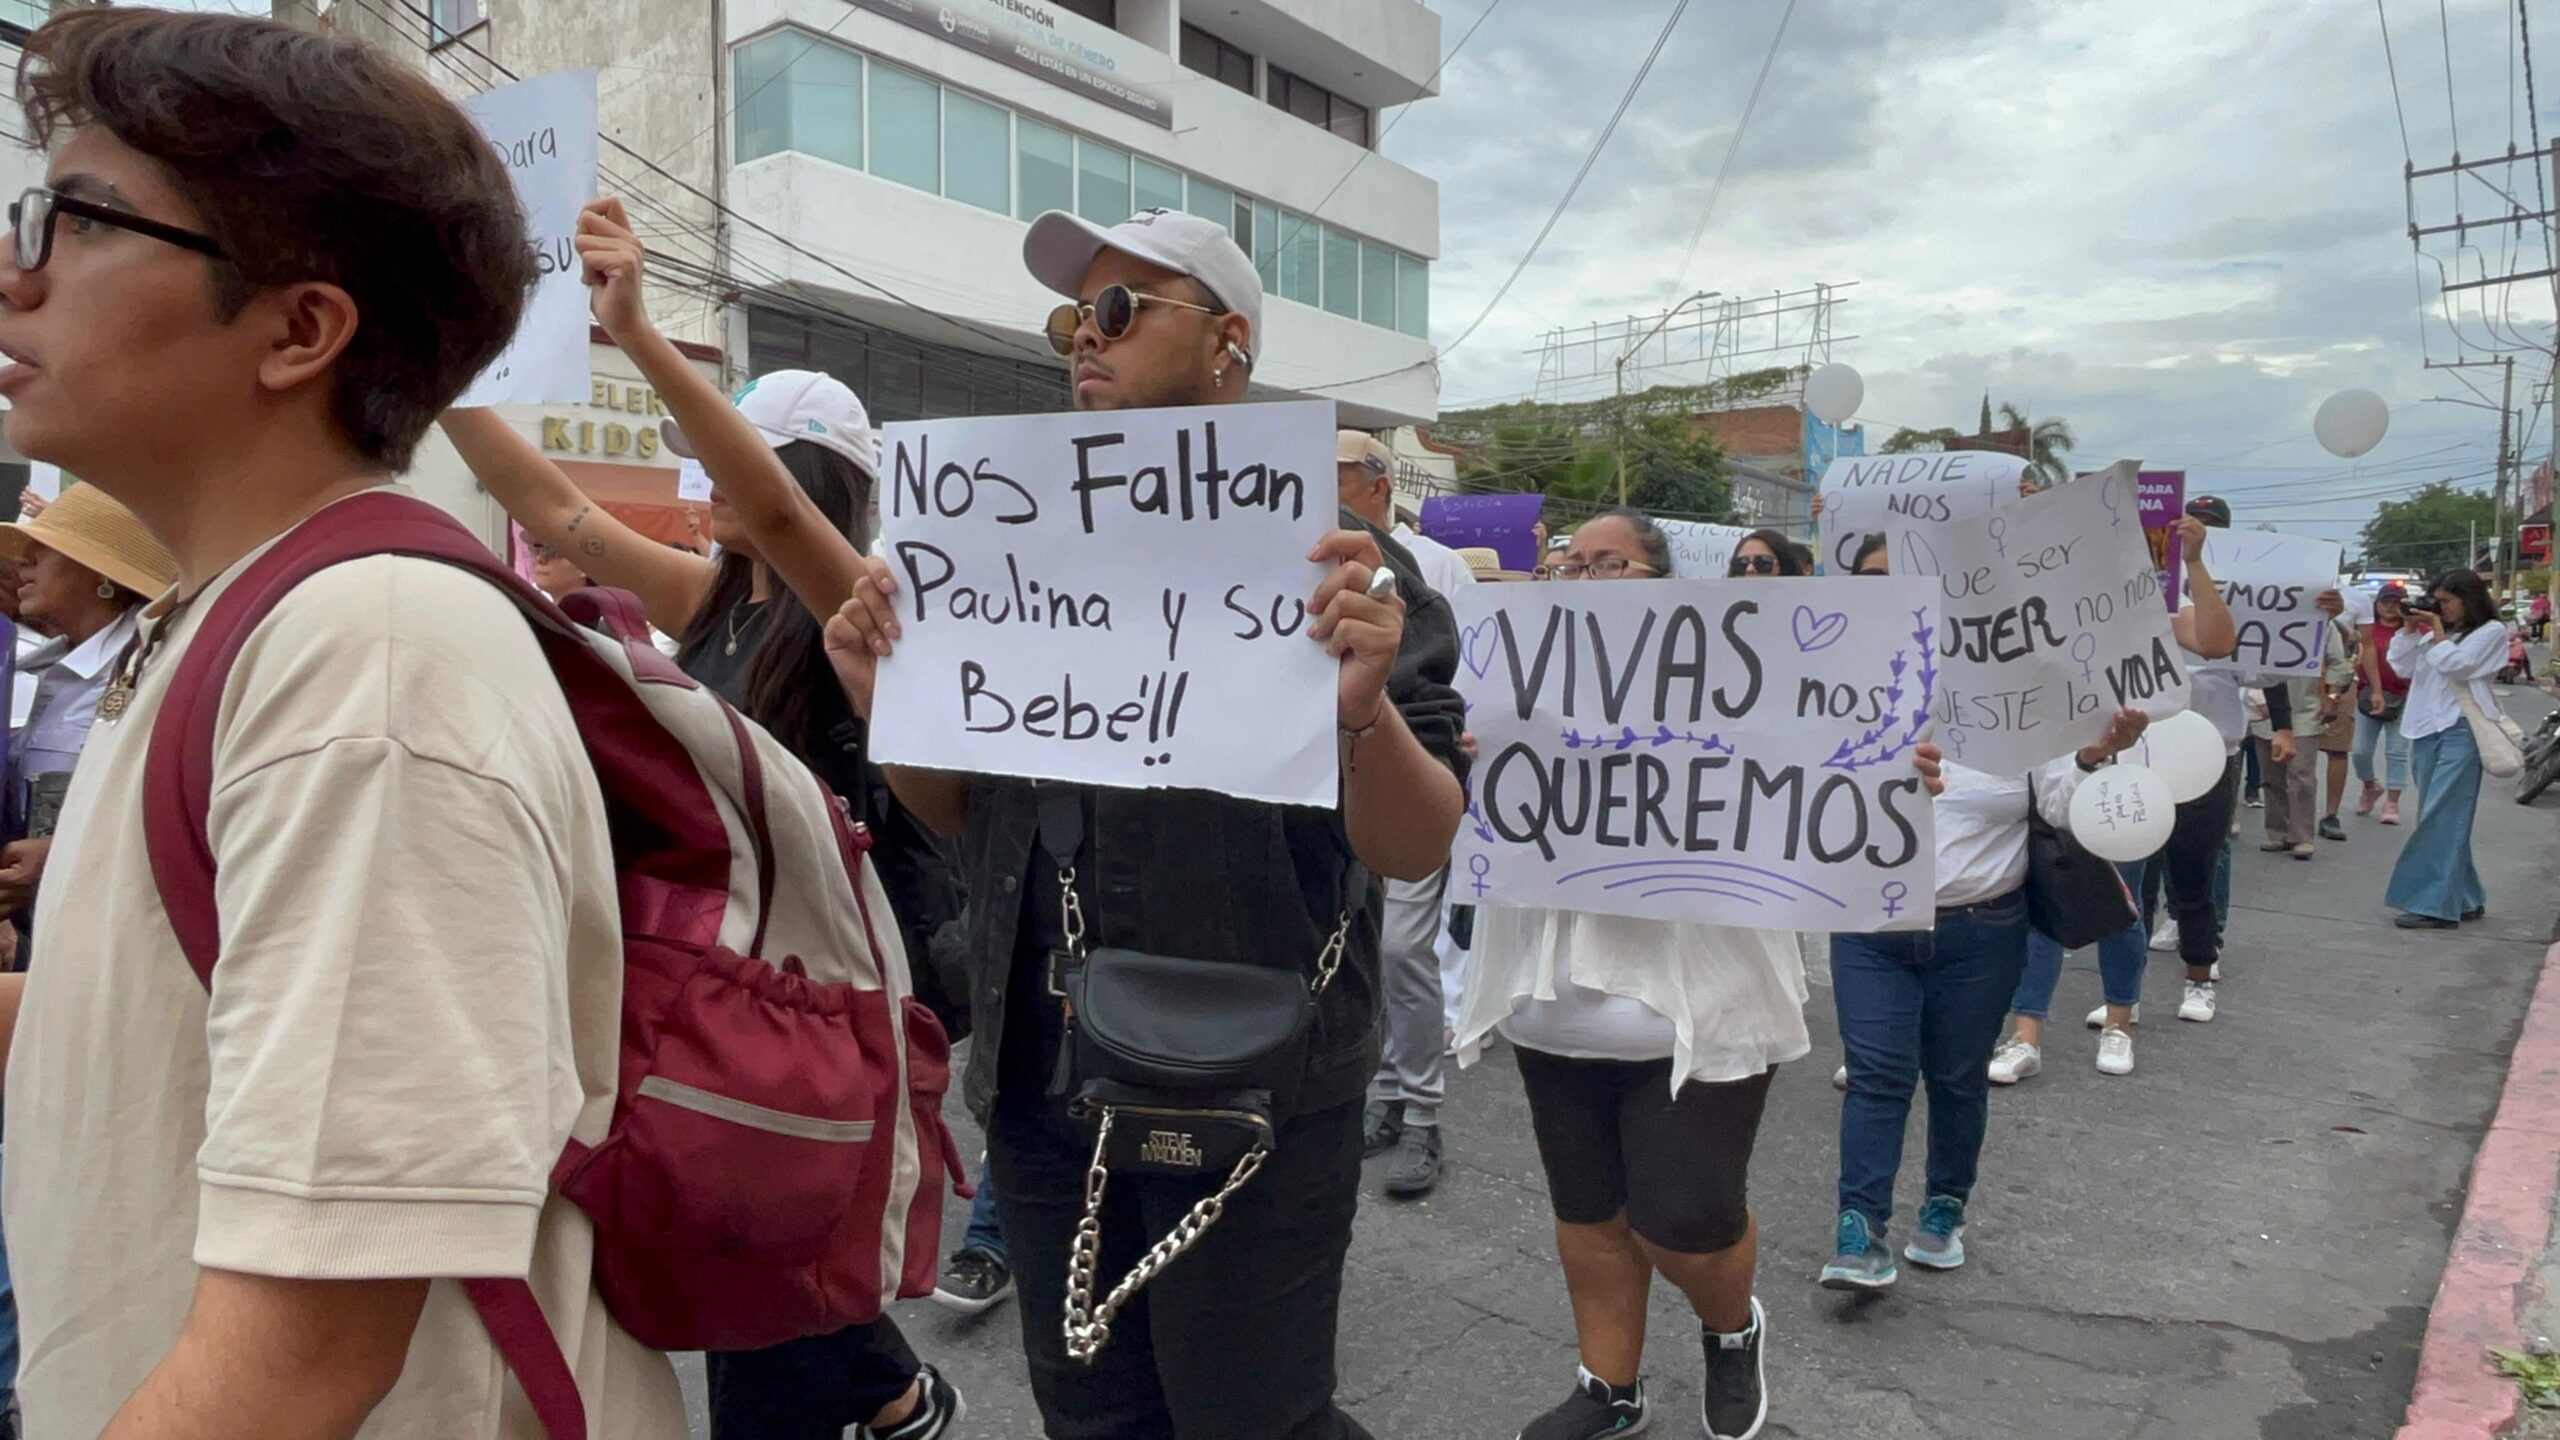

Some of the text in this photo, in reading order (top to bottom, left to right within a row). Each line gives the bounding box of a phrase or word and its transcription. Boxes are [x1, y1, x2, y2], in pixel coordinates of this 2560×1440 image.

[1015, 44, 1037, 63] AQUÍ
[1066, 65, 1077, 79] EN
[1079, 71, 1091, 84] UN
[1093, 75, 1125, 97] ESPACIO
[542, 415, 659, 459] KIDS
[893, 421, 1304, 534] Nos Faltan
[1842, 454, 1974, 488] NADIE
[2138, 483, 2175, 495] PARA
[1887, 493, 1951, 523] NOS
[2016, 535, 2083, 579] ser
[894, 540, 1112, 632] Paulina
[1163, 588, 1187, 661] y
[1940, 595, 2068, 664] UJER
[2075, 592, 2114, 627] no
[1495, 599, 1887, 725] VIVAS nos
[2104, 636, 2182, 708] VIDA
[1483, 740, 1919, 868] QUEREMOS
[1141, 1143, 1202, 1167] MADDEN
[1148, 1129, 1193, 1149] STEVE
